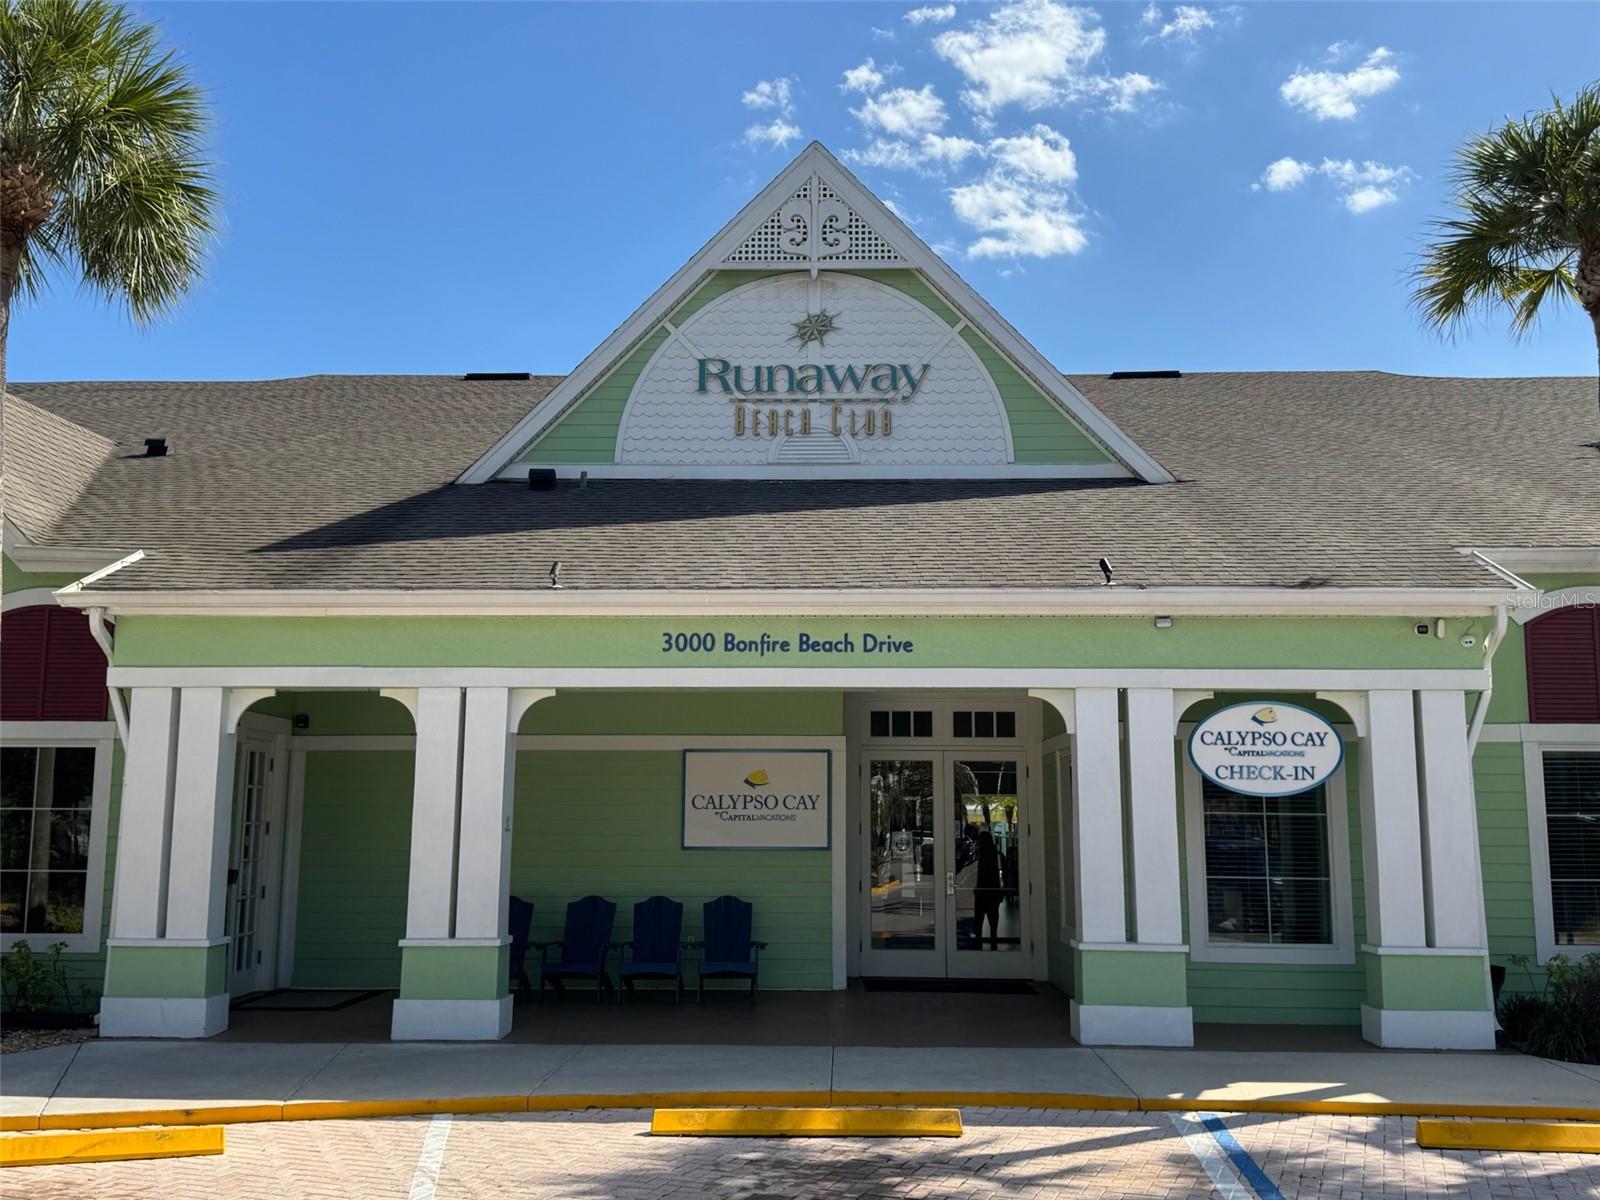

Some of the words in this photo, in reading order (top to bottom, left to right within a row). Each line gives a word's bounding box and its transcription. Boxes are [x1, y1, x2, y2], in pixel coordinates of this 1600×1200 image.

[696, 358, 931, 401] Runaway
[734, 404, 811, 436] BEACH
[831, 403, 892, 436] CLUB
[662, 632, 716, 653] 3000
[724, 632, 791, 656] Bonfire
[798, 632, 855, 653] Beach
[863, 632, 914, 653] Drive
[1200, 730, 1287, 746] CALYPSO
[1291, 731, 1328, 747] CAY
[1215, 765, 1316, 780] CHECK-IN
[691, 794, 779, 810] CALYPSO
[783, 794, 820, 810] CAY
